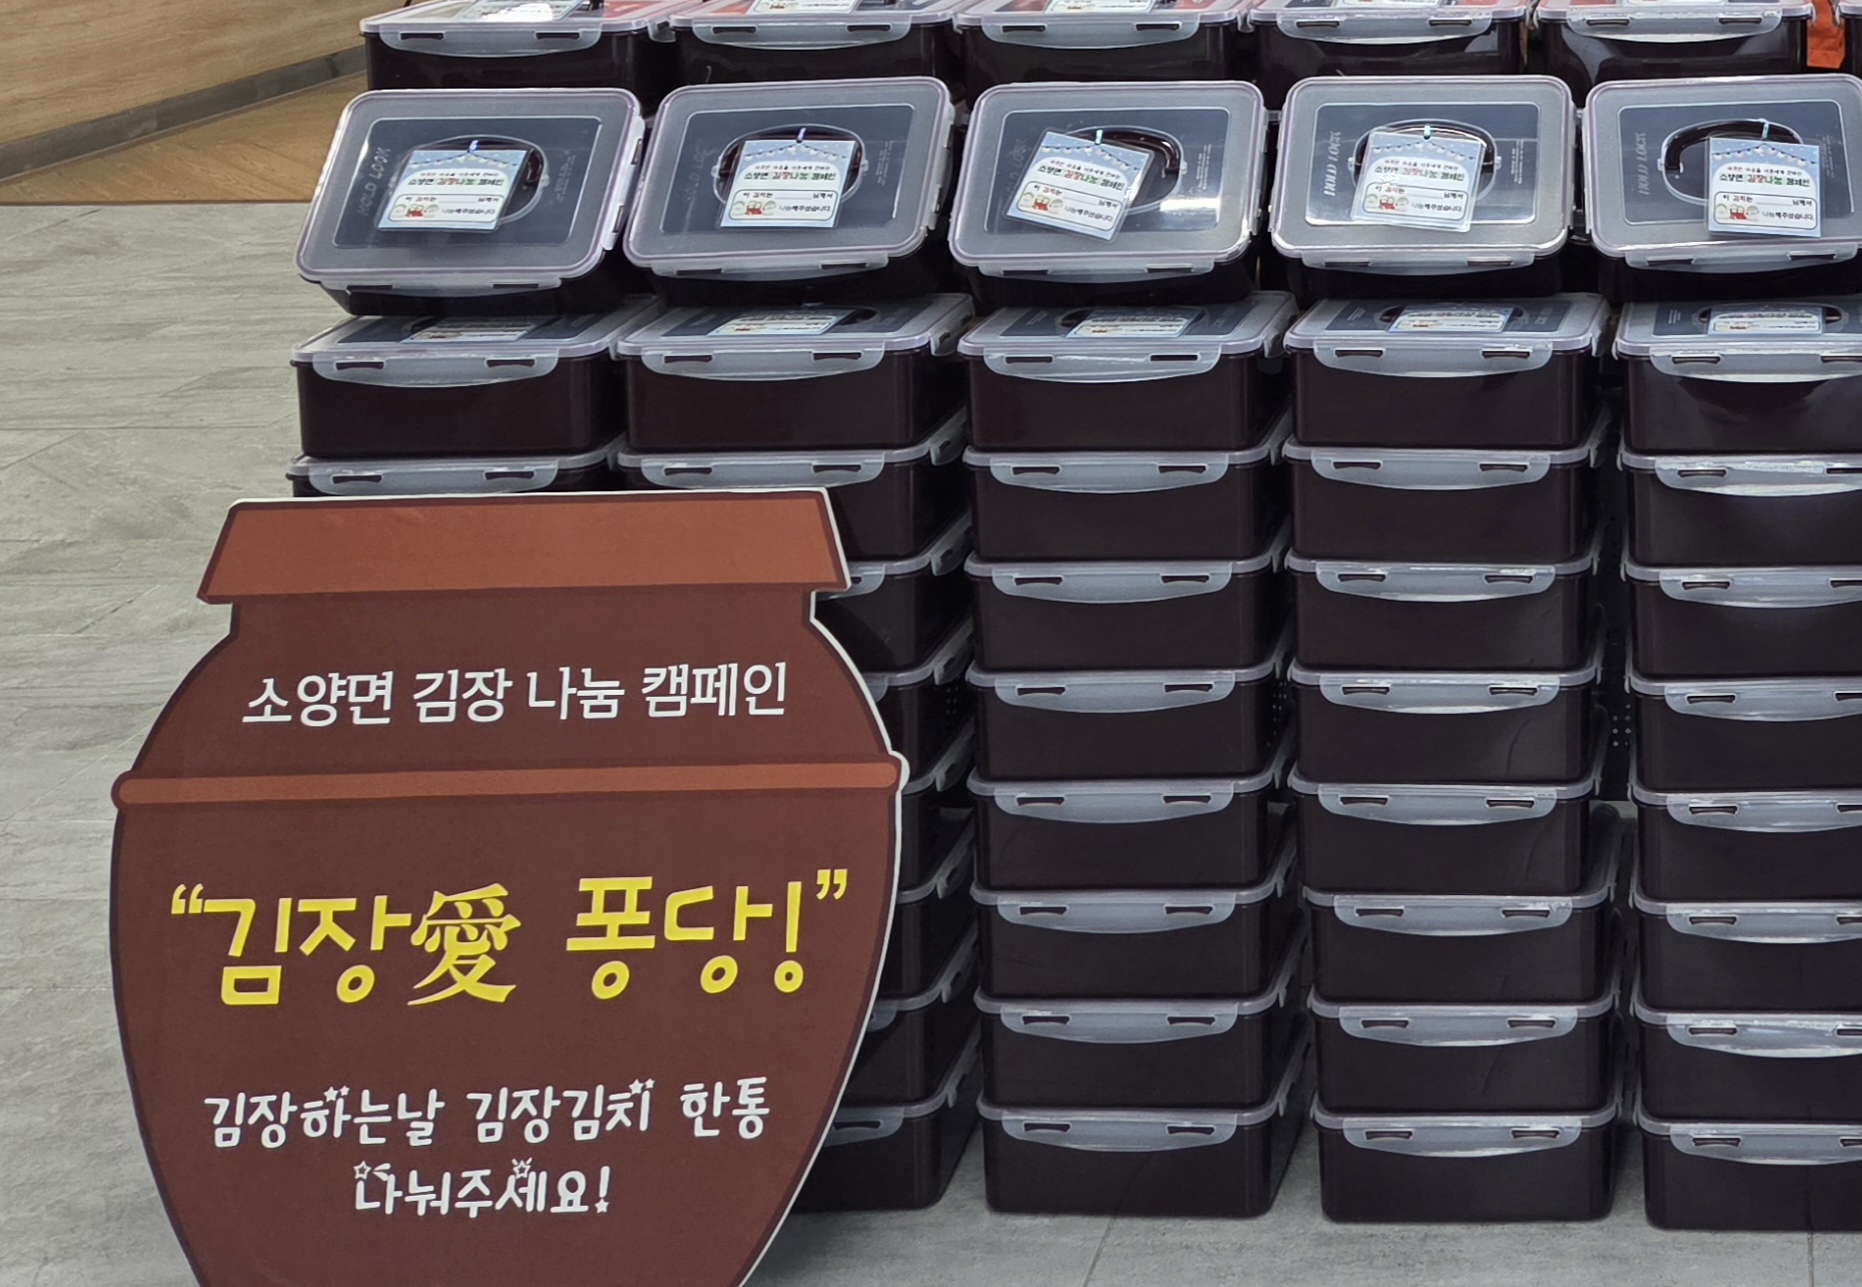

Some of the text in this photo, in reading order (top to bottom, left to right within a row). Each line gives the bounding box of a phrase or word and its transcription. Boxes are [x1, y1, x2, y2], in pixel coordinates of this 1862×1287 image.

[241, 661, 788, 727] 소양면 김장 나눔 캠페인
[169, 867, 849, 1007] “김장愛 퐁당!”
[203, 1075, 771, 1149] 김장하는날 김장김치 한통
[353, 1157, 612, 1218] 나눠주세요!
